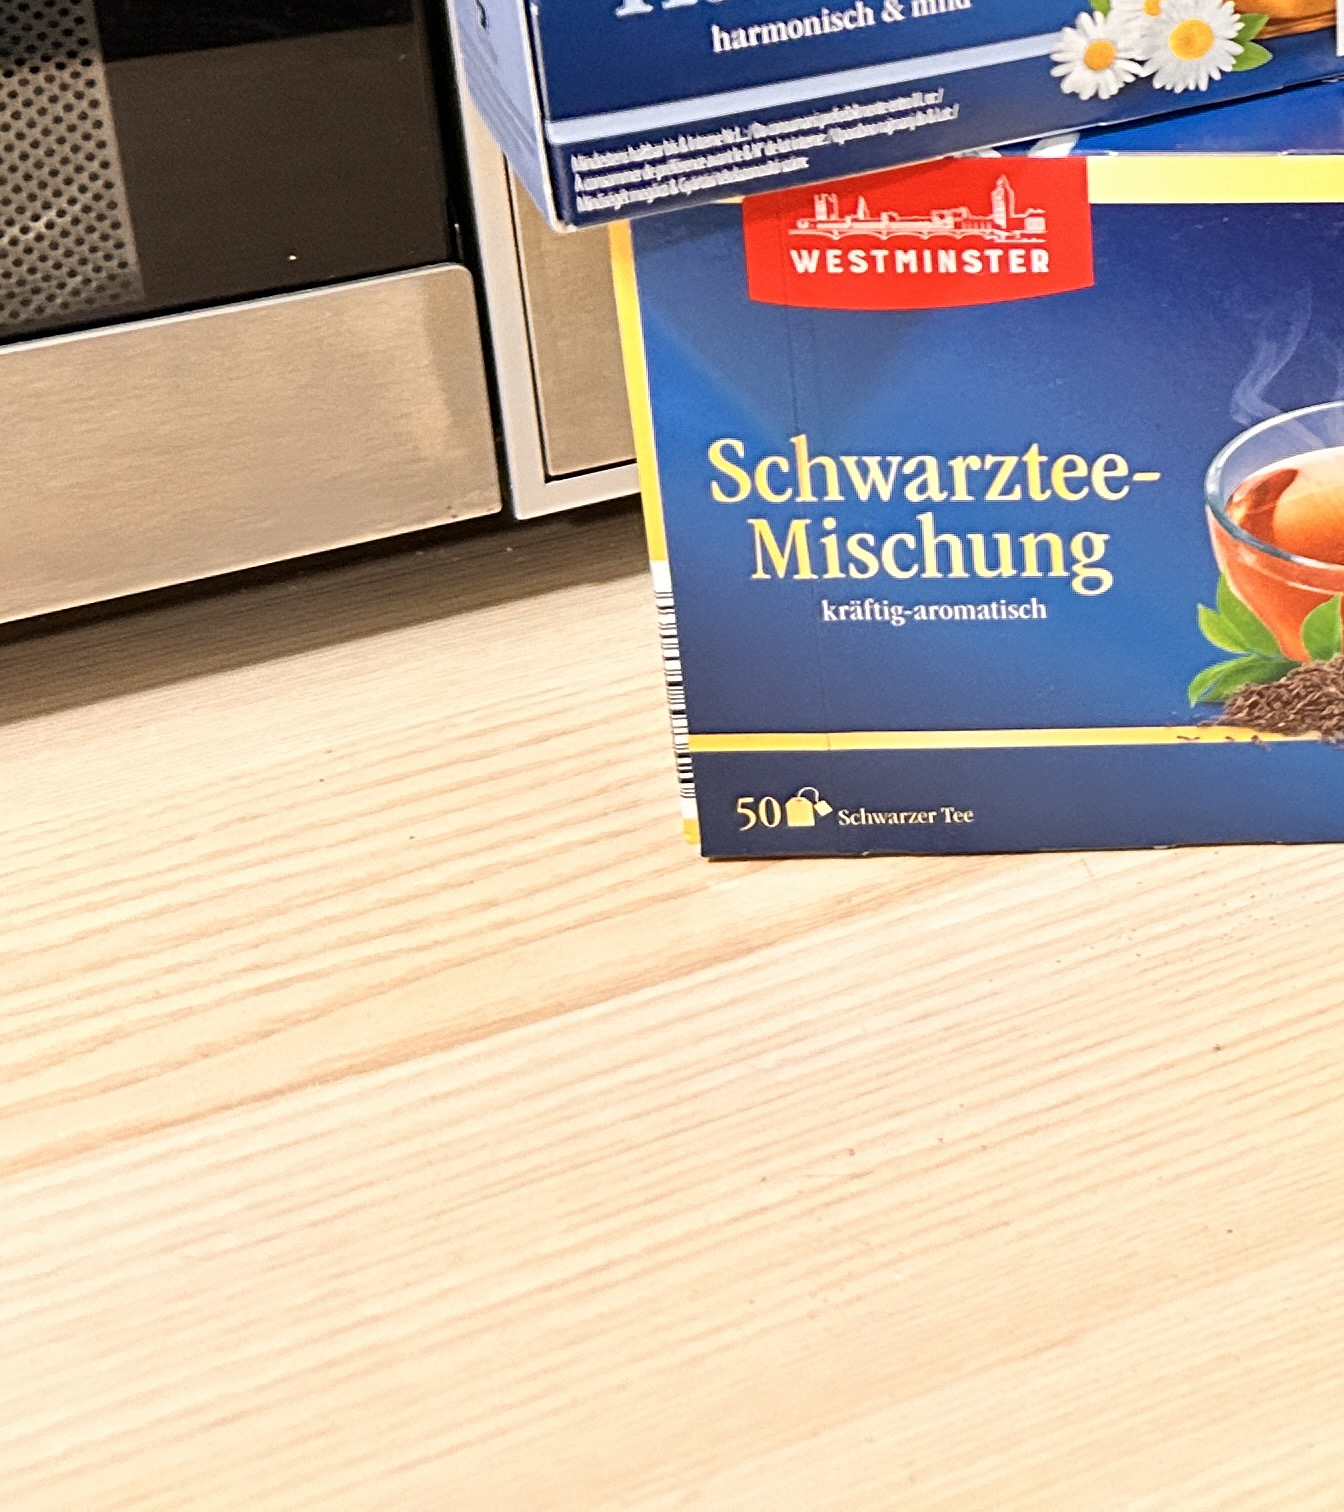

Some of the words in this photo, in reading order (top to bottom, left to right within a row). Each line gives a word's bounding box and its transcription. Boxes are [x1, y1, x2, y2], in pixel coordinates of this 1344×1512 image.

[711, 0, 876, 53] harmonisch
[789, 247, 1050, 275] WESTMINSTER
[707, 434, 1162, 504] Schwarztee-
[747, 512, 1115, 596] Mischung
[821, 596, 1049, 626] kräftig-aromatisch
[736, 795, 783, 832] 50
[837, 805, 937, 827] Schwarzer
[940, 805, 975, 824] Tee
